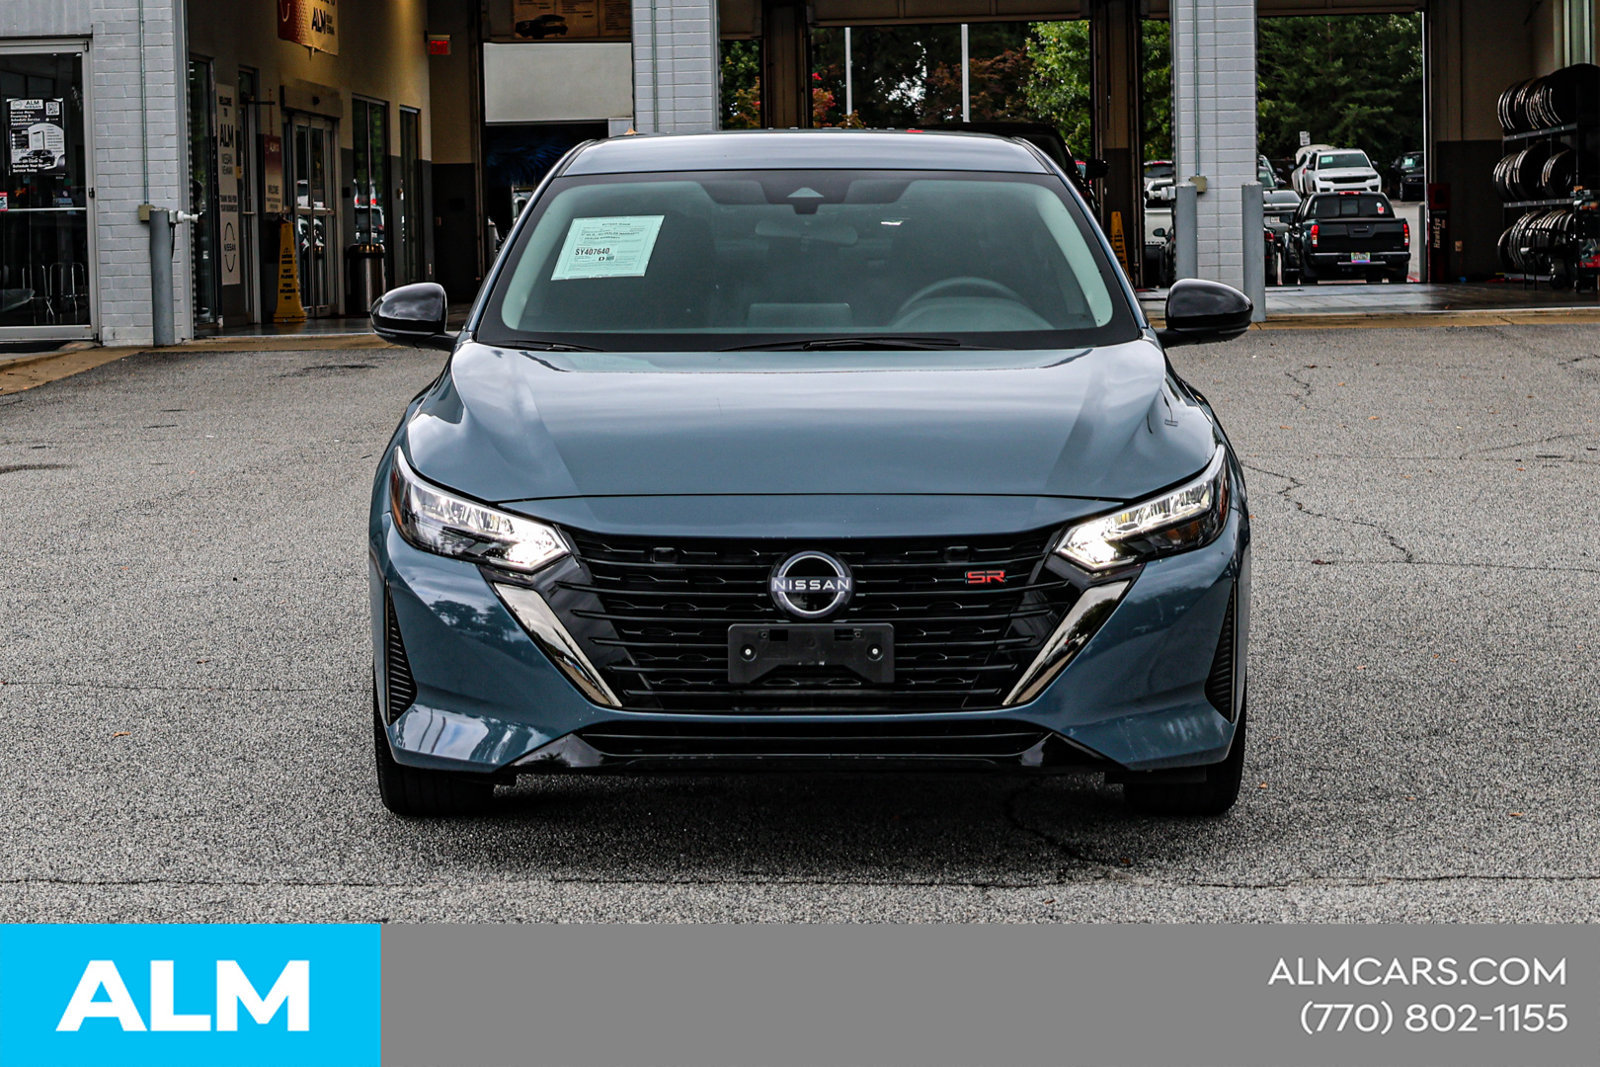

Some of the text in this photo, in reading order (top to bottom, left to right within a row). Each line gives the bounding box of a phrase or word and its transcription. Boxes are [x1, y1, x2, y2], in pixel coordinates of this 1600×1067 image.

[312, 7, 326, 34] ALM
[220, 124, 234, 148] ALM
[575, 247, 610, 256] SY407640
[966, 570, 1005, 584] SR
[774, 580, 850, 591] NISSAN
